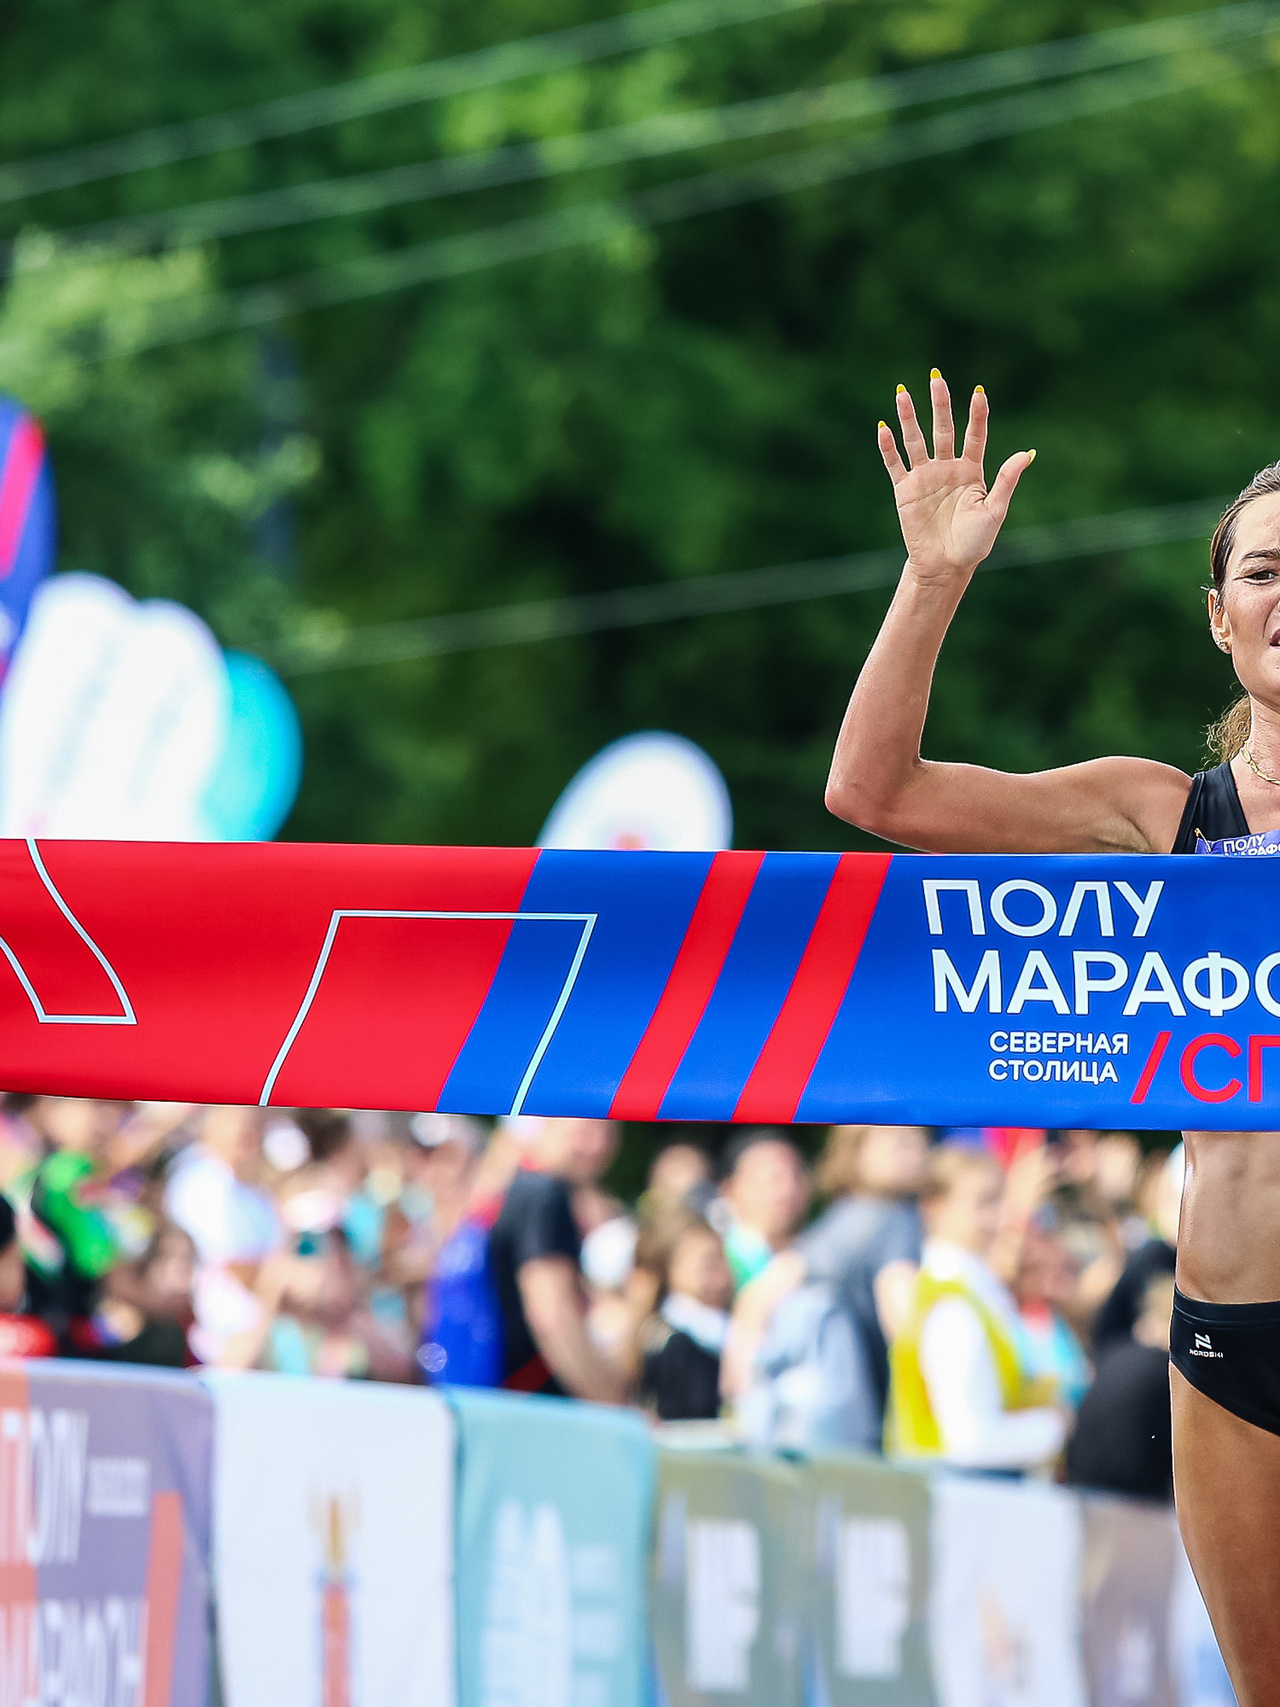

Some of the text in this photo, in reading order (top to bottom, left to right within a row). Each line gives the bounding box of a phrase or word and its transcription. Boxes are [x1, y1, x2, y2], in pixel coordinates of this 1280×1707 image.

[1223, 833, 1266, 853] ПОЛУ
[922, 879, 1165, 938] ПОЛУ
[988, 1030, 1129, 1055] СЕВЕРНАЯ
[988, 1058, 1120, 1086] СТОЛИЦА
